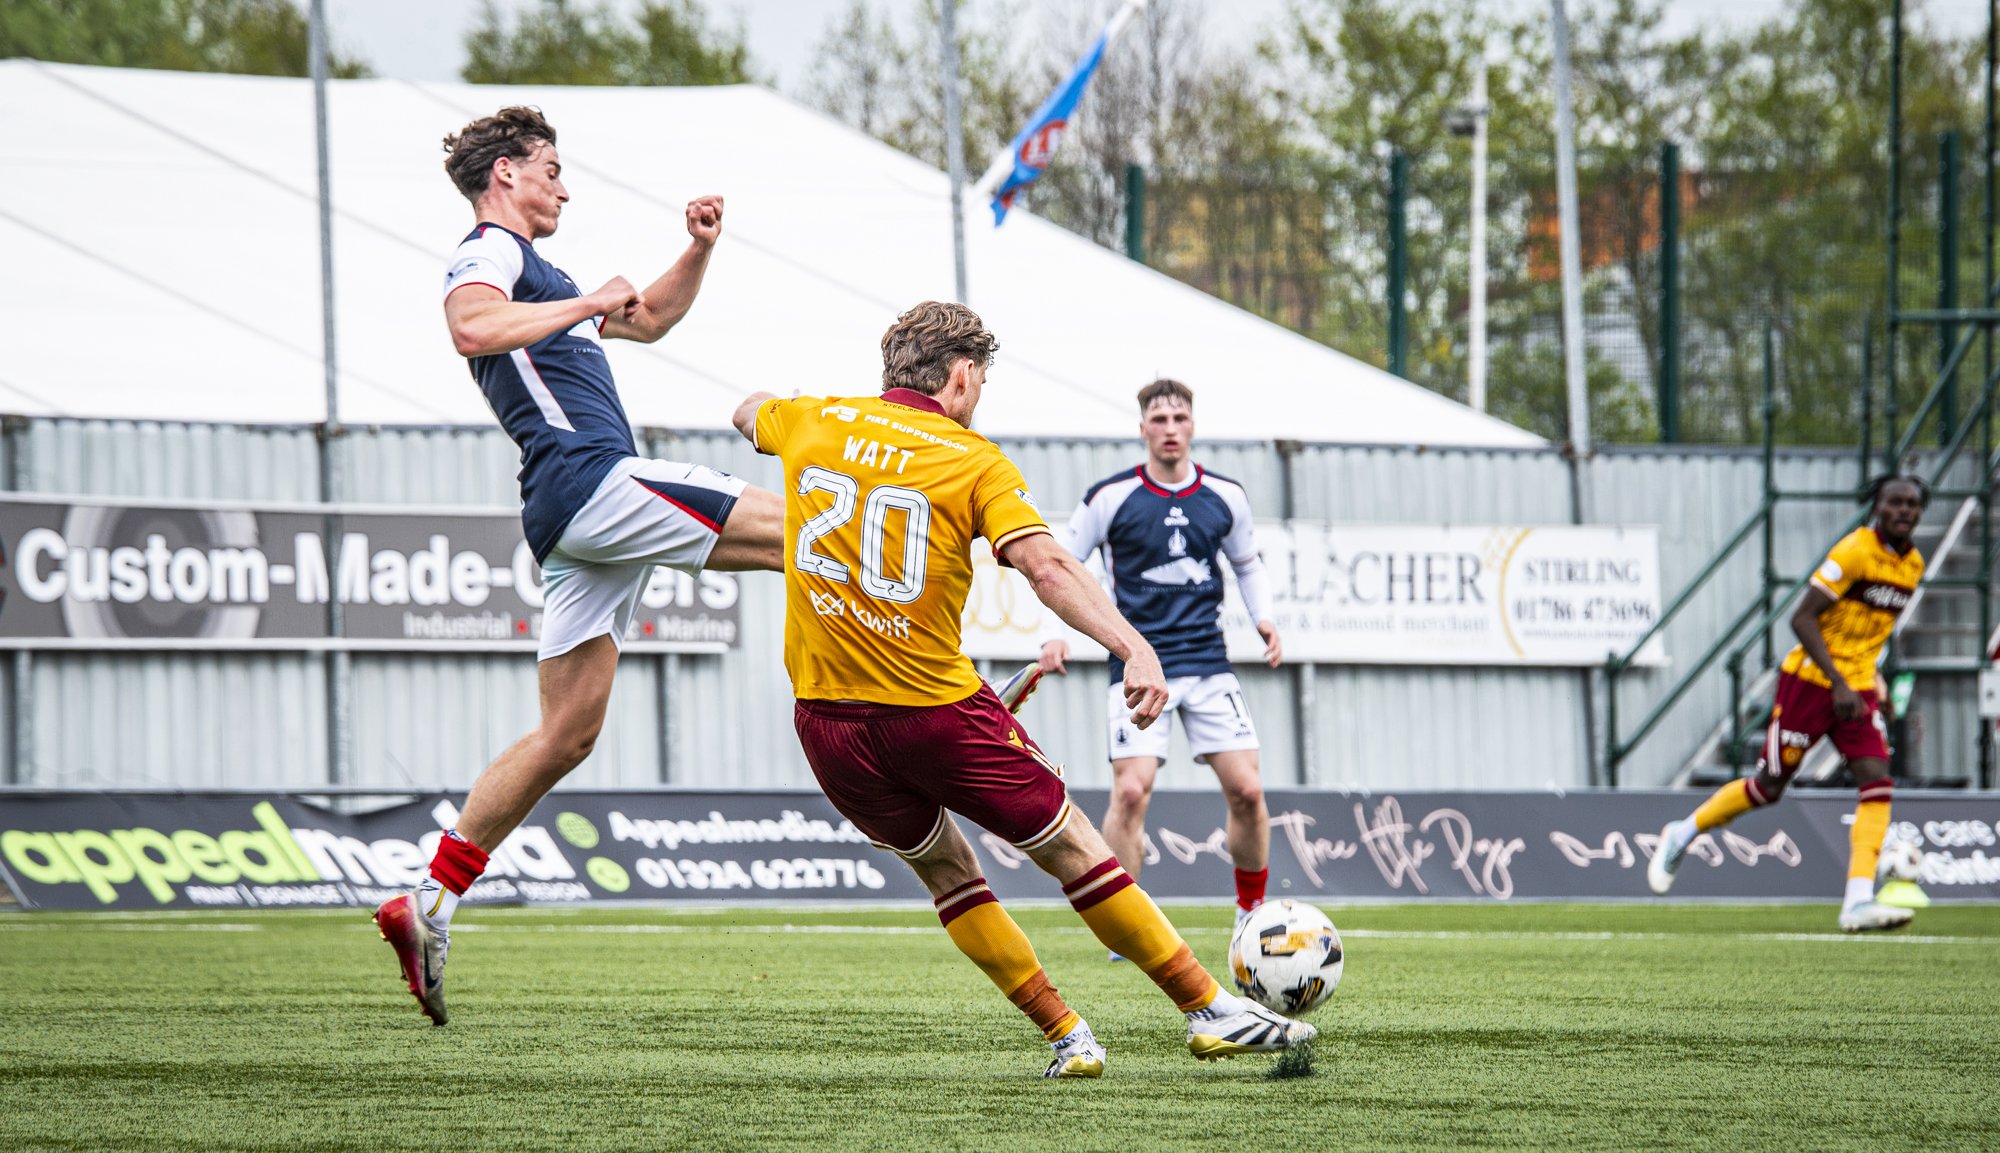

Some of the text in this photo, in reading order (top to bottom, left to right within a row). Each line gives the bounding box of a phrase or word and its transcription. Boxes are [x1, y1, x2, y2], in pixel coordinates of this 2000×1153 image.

[864, 414, 890, 426] FIRE
[842, 435, 916, 475] WATT
[795, 464, 932, 605] 20
[1524, 558, 1642, 584] STIRLING
[403, 611, 512, 639] Industrial
[656, 613, 737, 640] Marine
[851, 600, 910, 639] kwiff
[635, 857, 886, 889] 01324 622776
